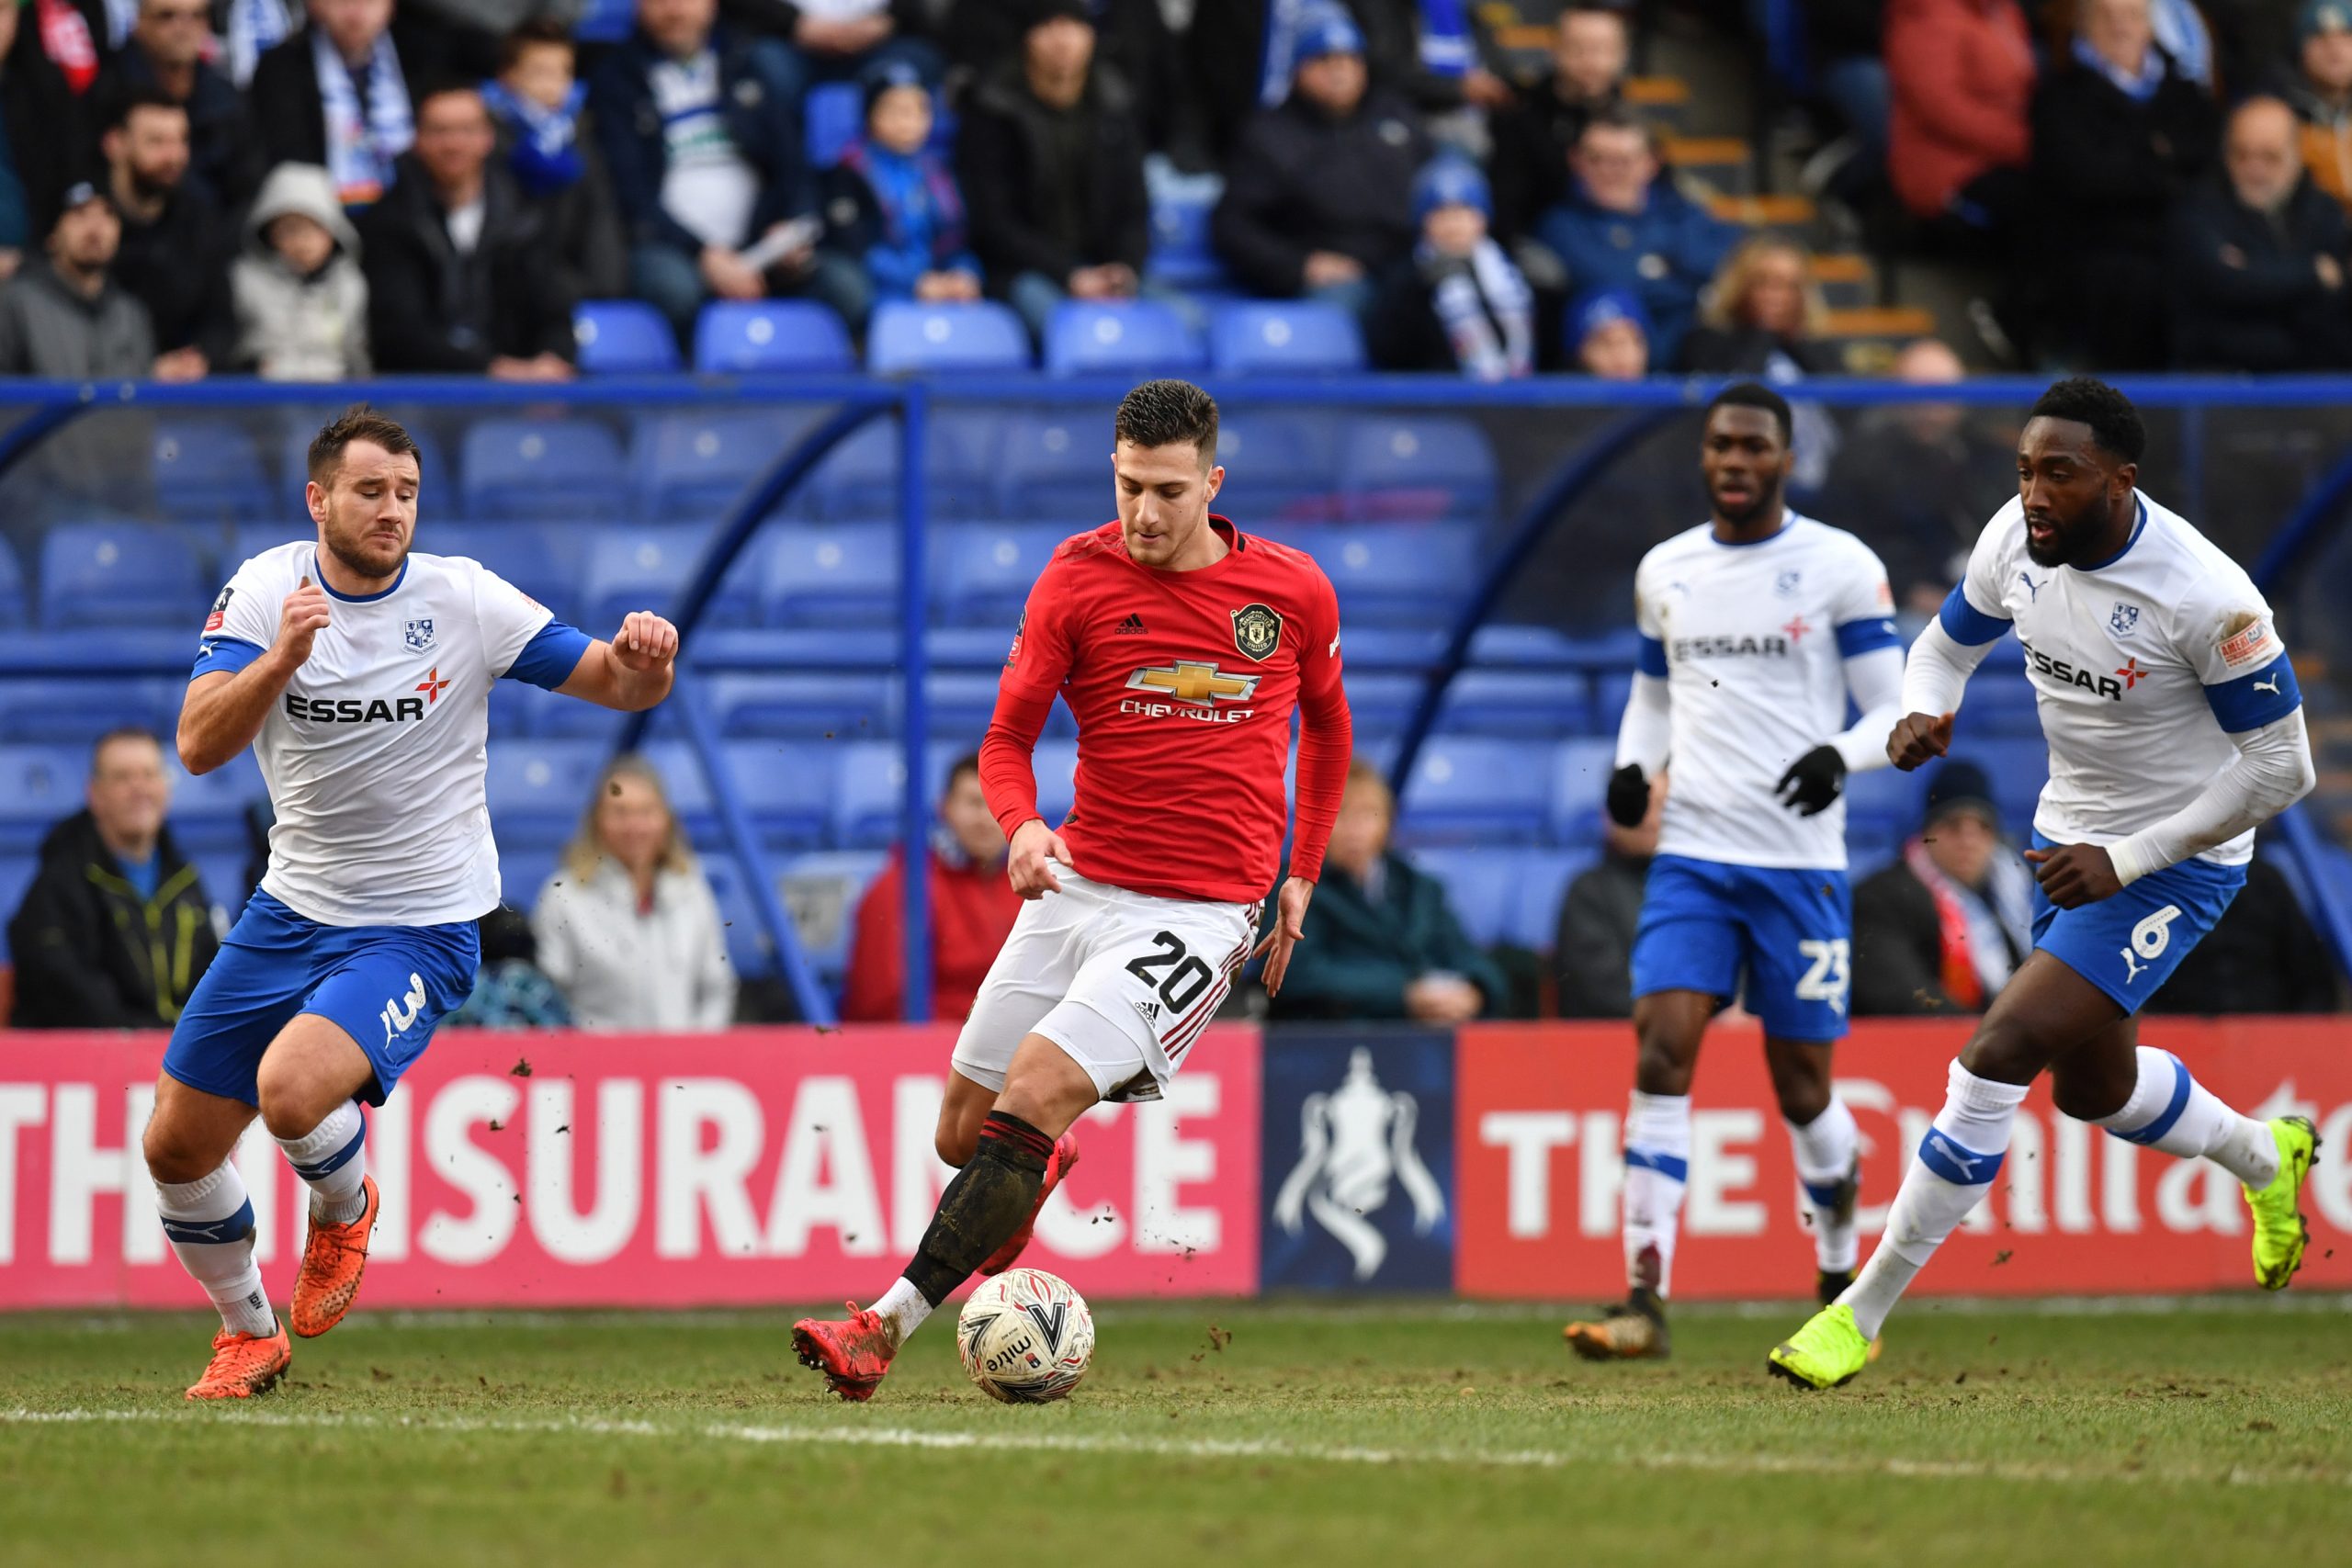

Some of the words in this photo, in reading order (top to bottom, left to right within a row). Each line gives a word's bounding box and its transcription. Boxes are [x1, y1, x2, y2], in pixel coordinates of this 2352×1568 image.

[1114, 626, 1148, 634] adidas
[1247, 641, 1268, 649] UNITED
[1674, 635, 1787, 661] ESSAR
[287, 693, 424, 723] ESSAR
[1120, 699, 1254, 723] CHEVROLET
[2131, 904, 2182, 960] 6
[1125, 930, 1213, 1015] 20
[387, 972, 426, 1032] 3
[1134, 1001, 1156, 1030] adidas
[986, 1335, 1032, 1371] mitre
